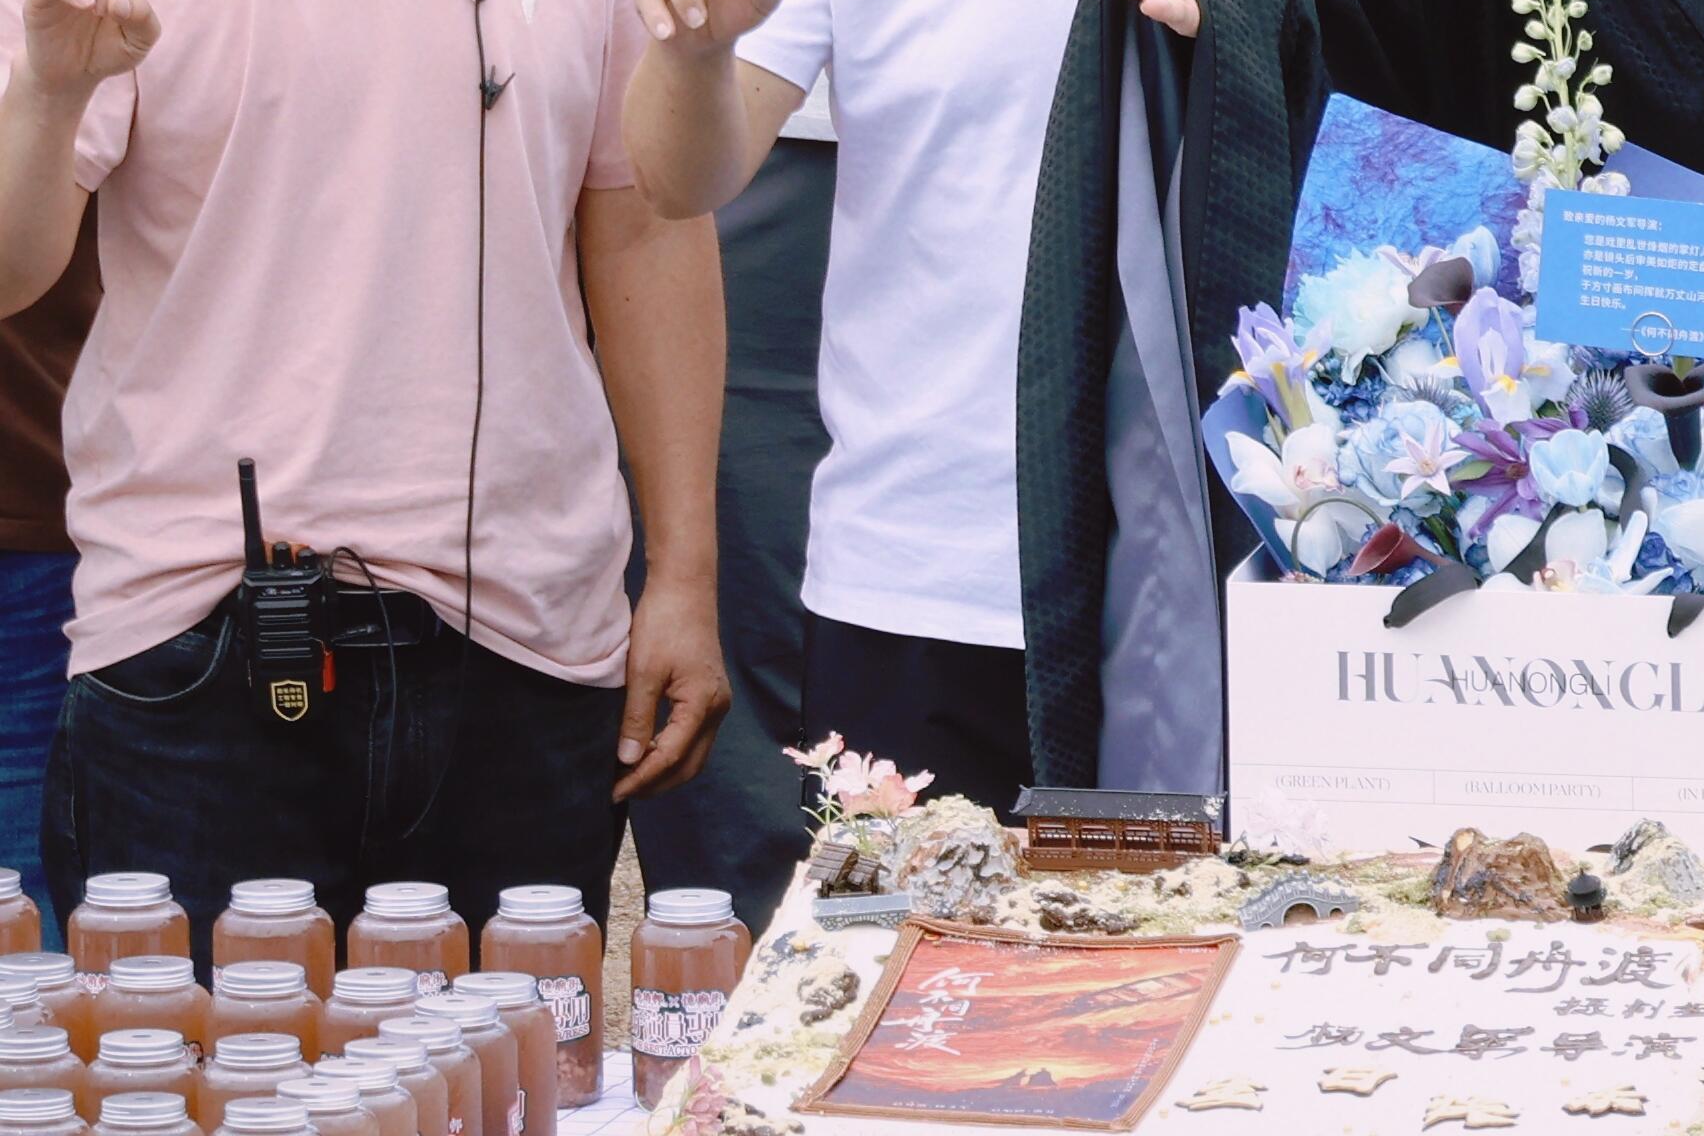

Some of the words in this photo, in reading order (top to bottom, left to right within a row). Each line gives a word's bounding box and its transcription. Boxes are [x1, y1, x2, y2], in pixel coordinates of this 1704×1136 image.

[1262, 940, 1675, 994] 何不同舟渡
[1275, 1021, 1698, 1061] 杨文军导演
